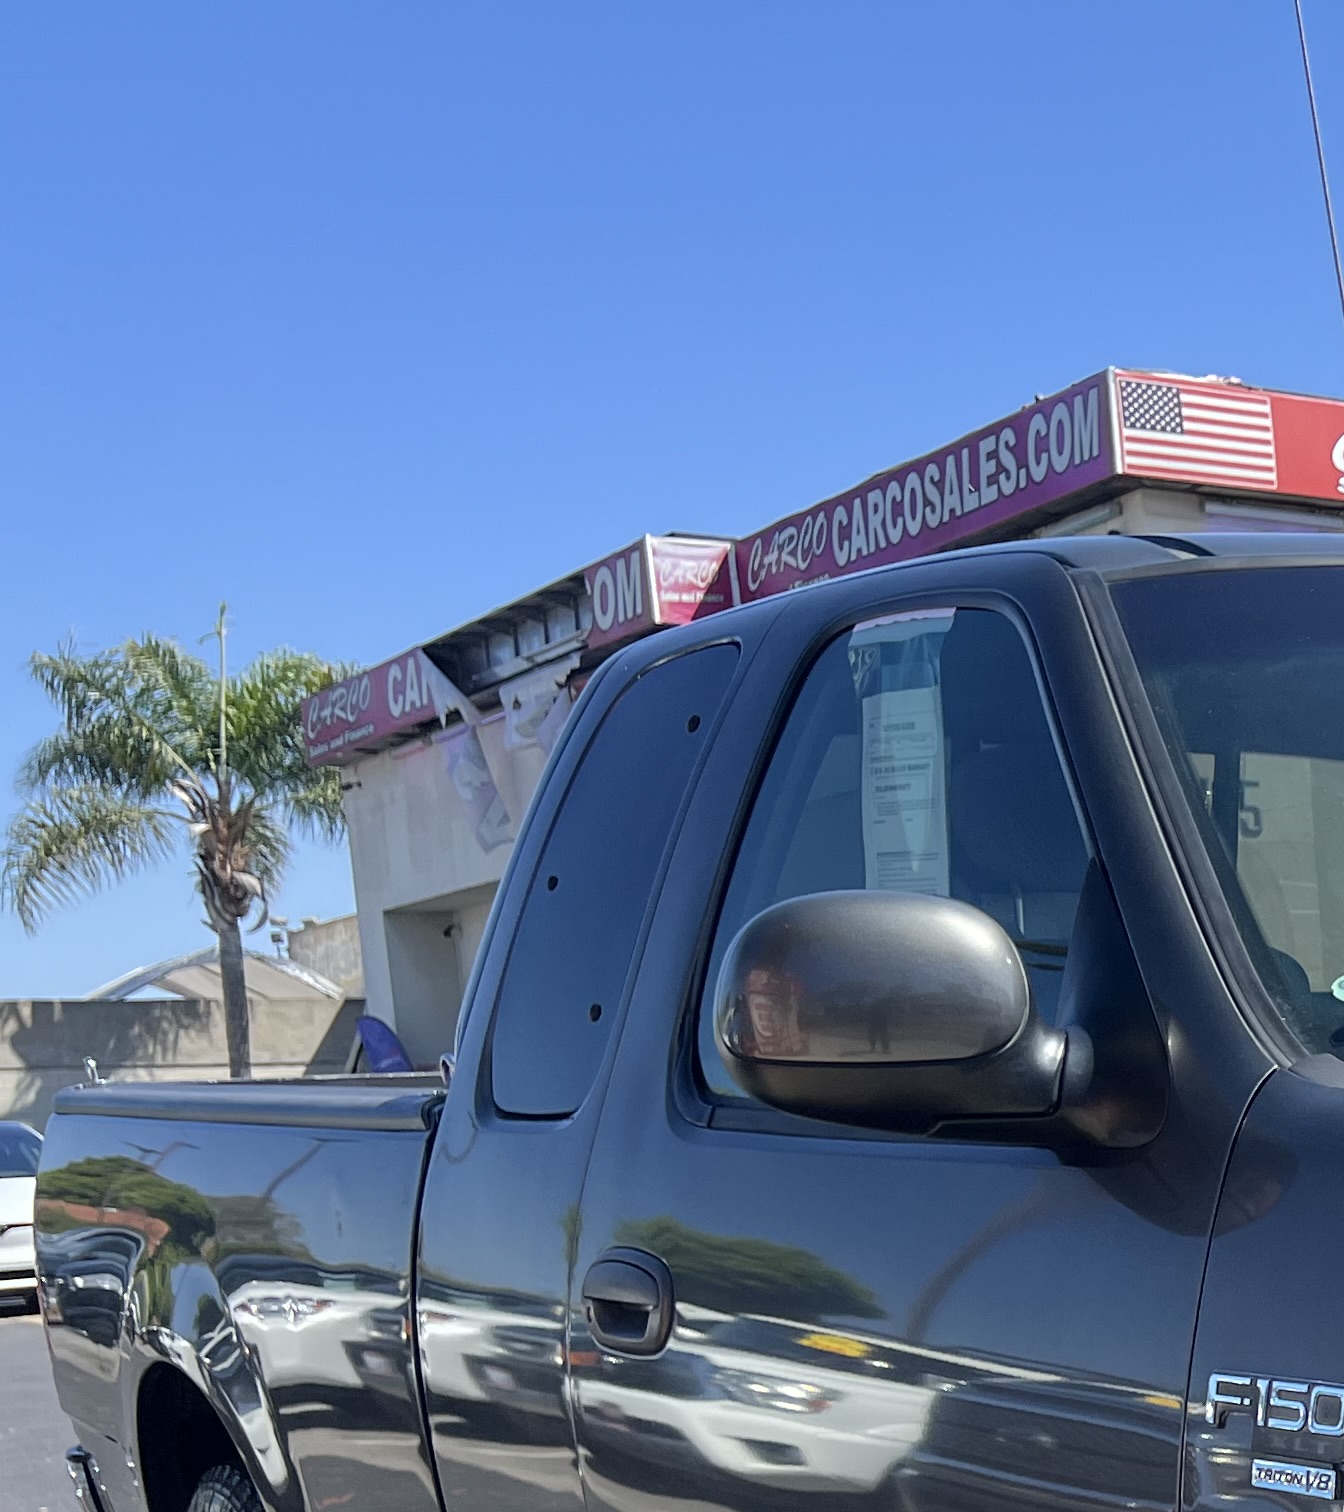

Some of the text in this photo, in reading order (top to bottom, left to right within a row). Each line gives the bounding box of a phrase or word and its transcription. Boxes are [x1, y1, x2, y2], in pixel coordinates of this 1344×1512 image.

[748, 386, 1101, 592] CARCO CARCOSALES.COM
[308, 674, 370, 739] CARCO
[1255, 1466, 1332, 1493] TRITON V8
